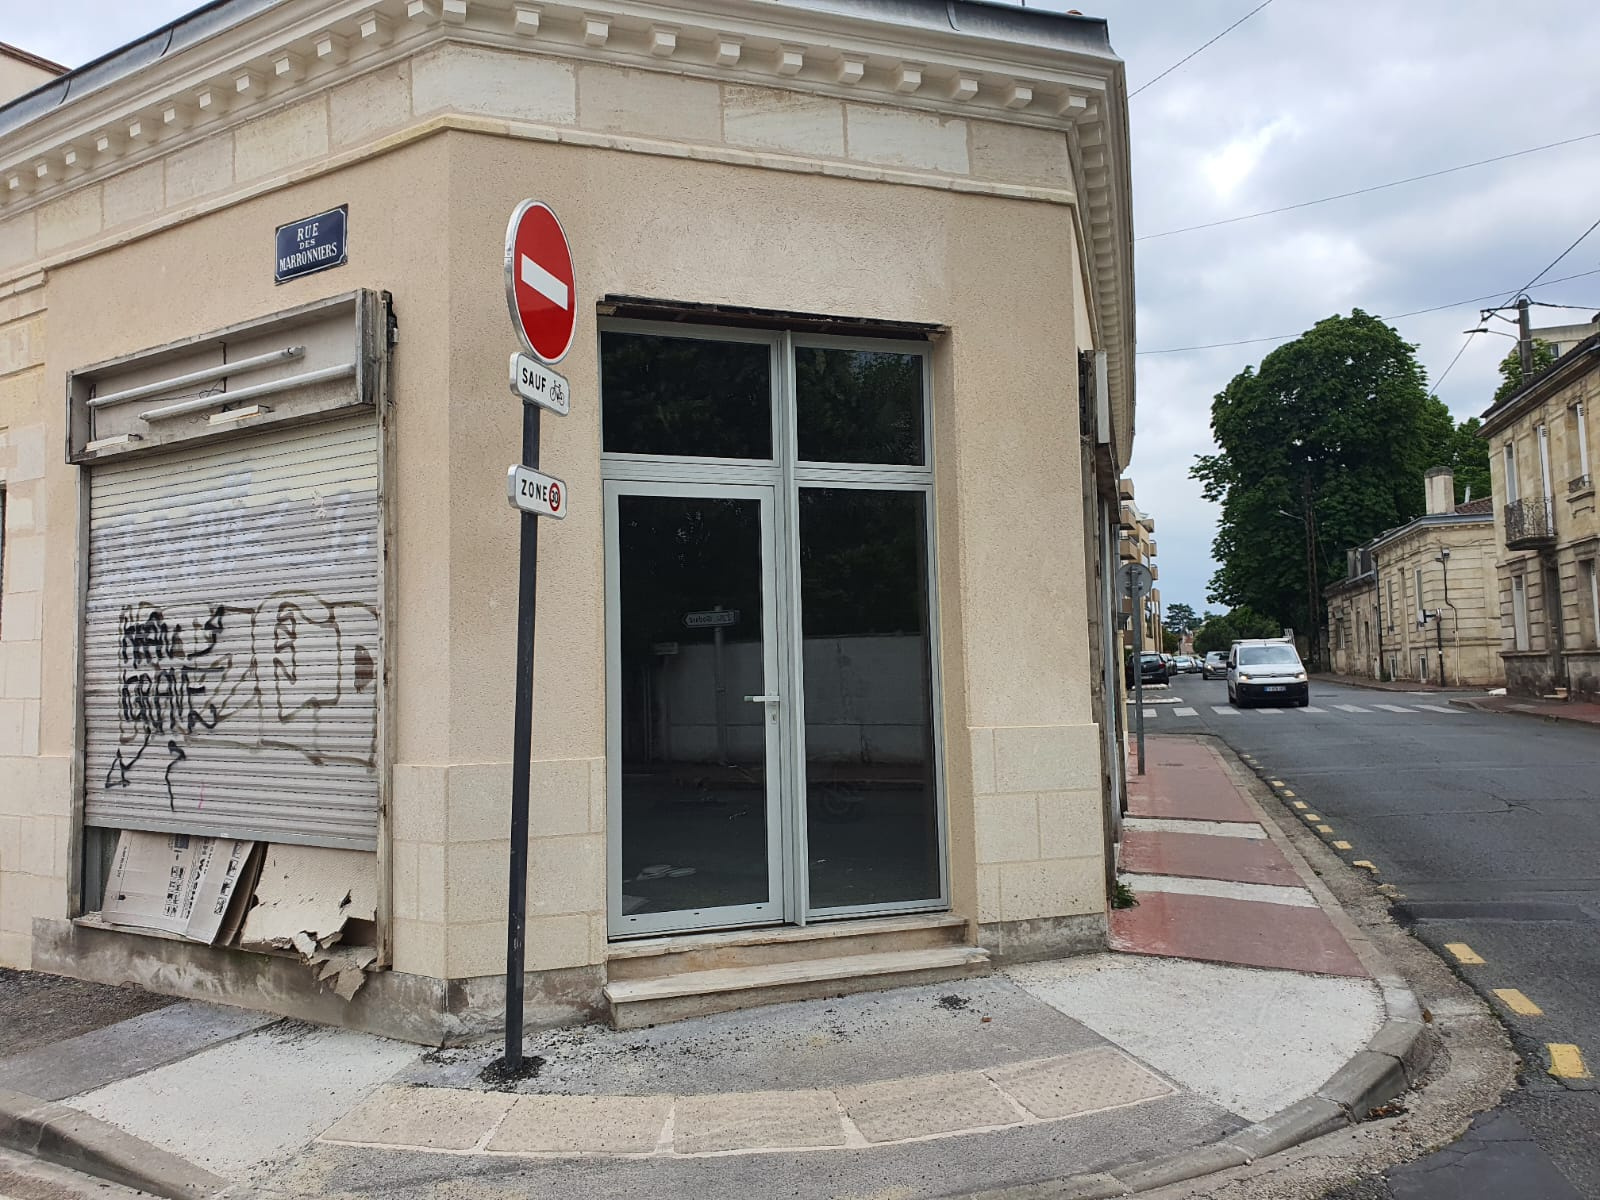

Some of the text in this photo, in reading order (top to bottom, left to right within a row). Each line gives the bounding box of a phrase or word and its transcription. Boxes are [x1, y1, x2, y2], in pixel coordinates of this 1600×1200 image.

[297, 222, 319, 241] RUE
[299, 238, 316, 250] DES
[279, 242, 337, 272] MARRONNIERS
[522, 367, 547, 393] SAUF
[521, 478, 559, 504] ZONE 30
